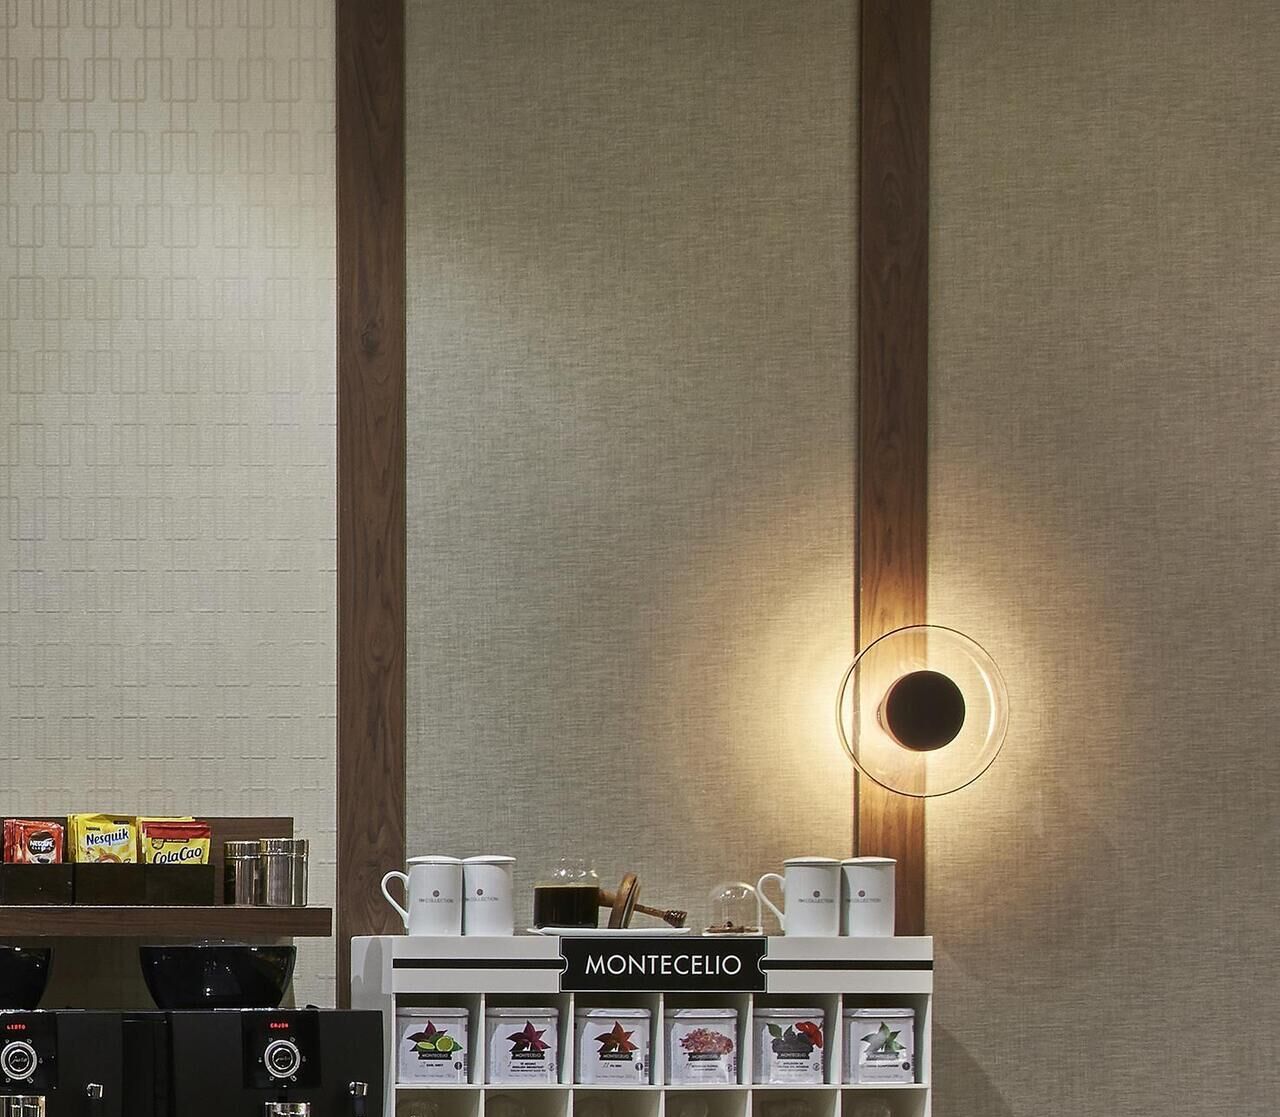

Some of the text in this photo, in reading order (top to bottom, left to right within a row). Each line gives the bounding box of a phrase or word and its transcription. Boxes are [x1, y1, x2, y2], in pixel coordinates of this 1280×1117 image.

[86, 828, 129, 846] Nesquik
[153, 847, 202, 864] ColaCao
[584, 954, 742, 975] MONTECELIO
